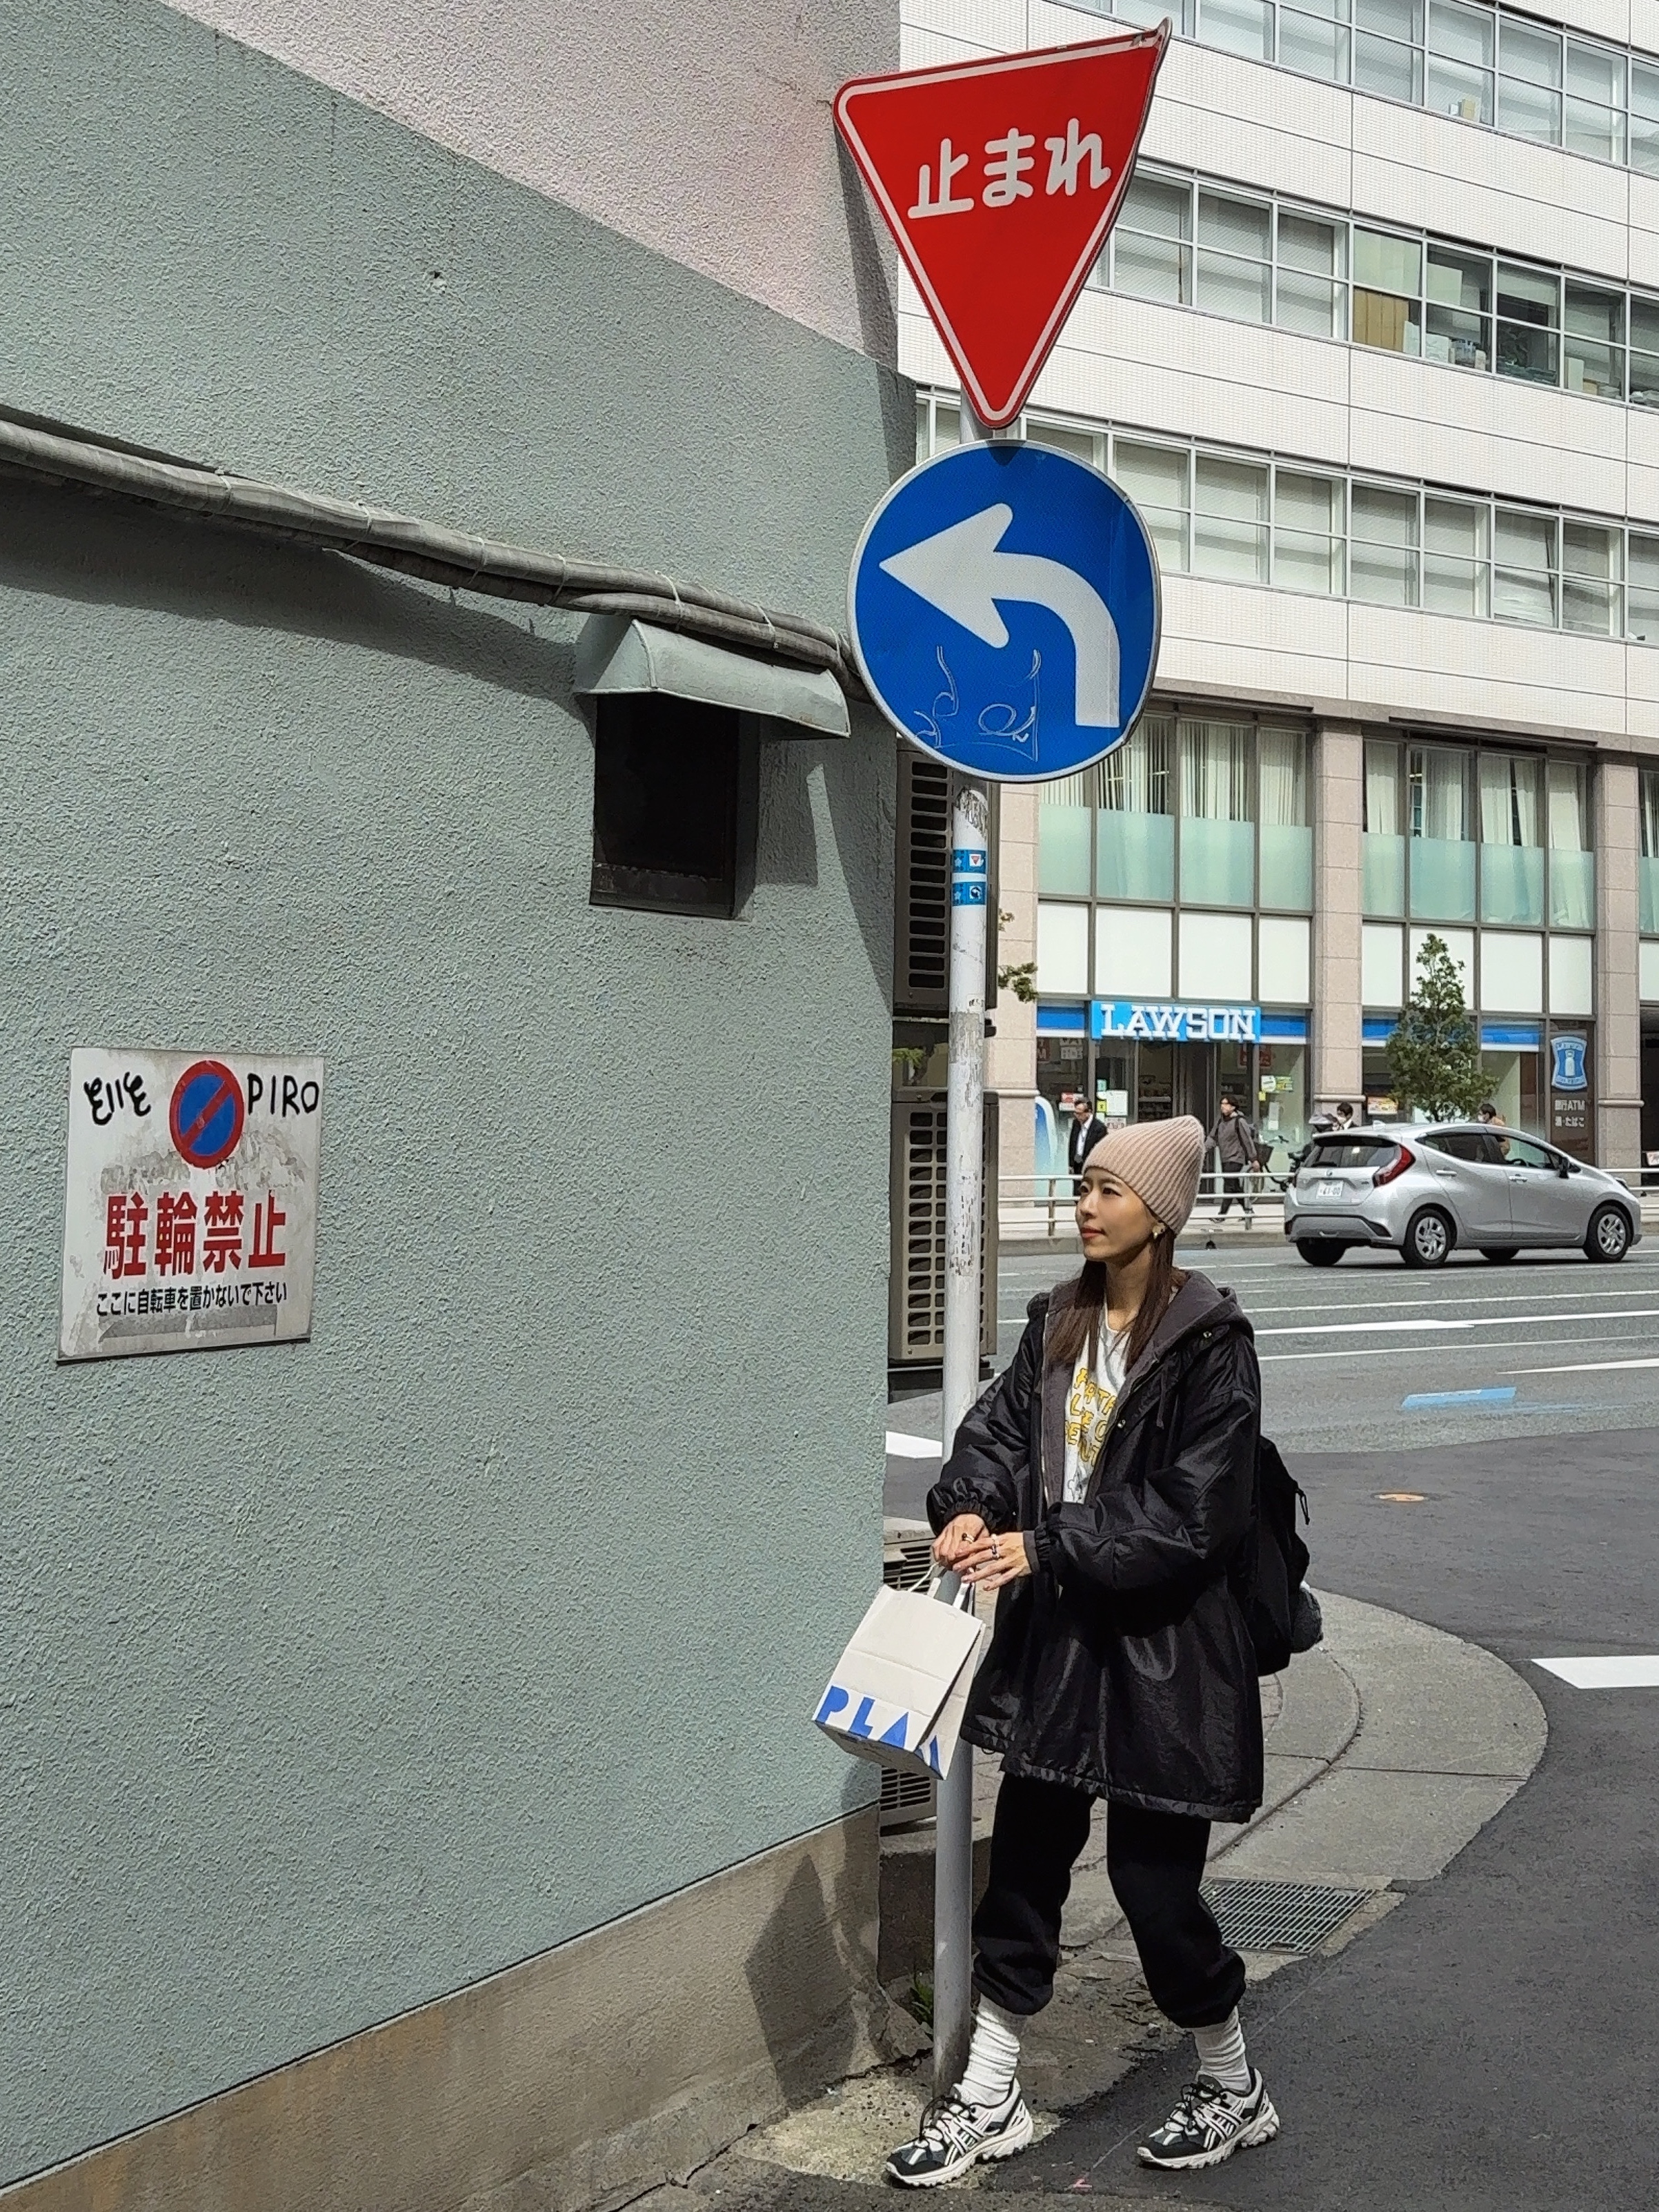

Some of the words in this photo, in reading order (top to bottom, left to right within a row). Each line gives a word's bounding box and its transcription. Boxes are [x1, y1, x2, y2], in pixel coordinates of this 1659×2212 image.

[907, 118, 1112, 219] 止まれ
[1100, 1003, 1256, 1040] LAWSON
[103, 1189, 286, 1280] 駐輪禁止
[96, 1281, 288, 1316] ここに自転車を置かないで下さい
